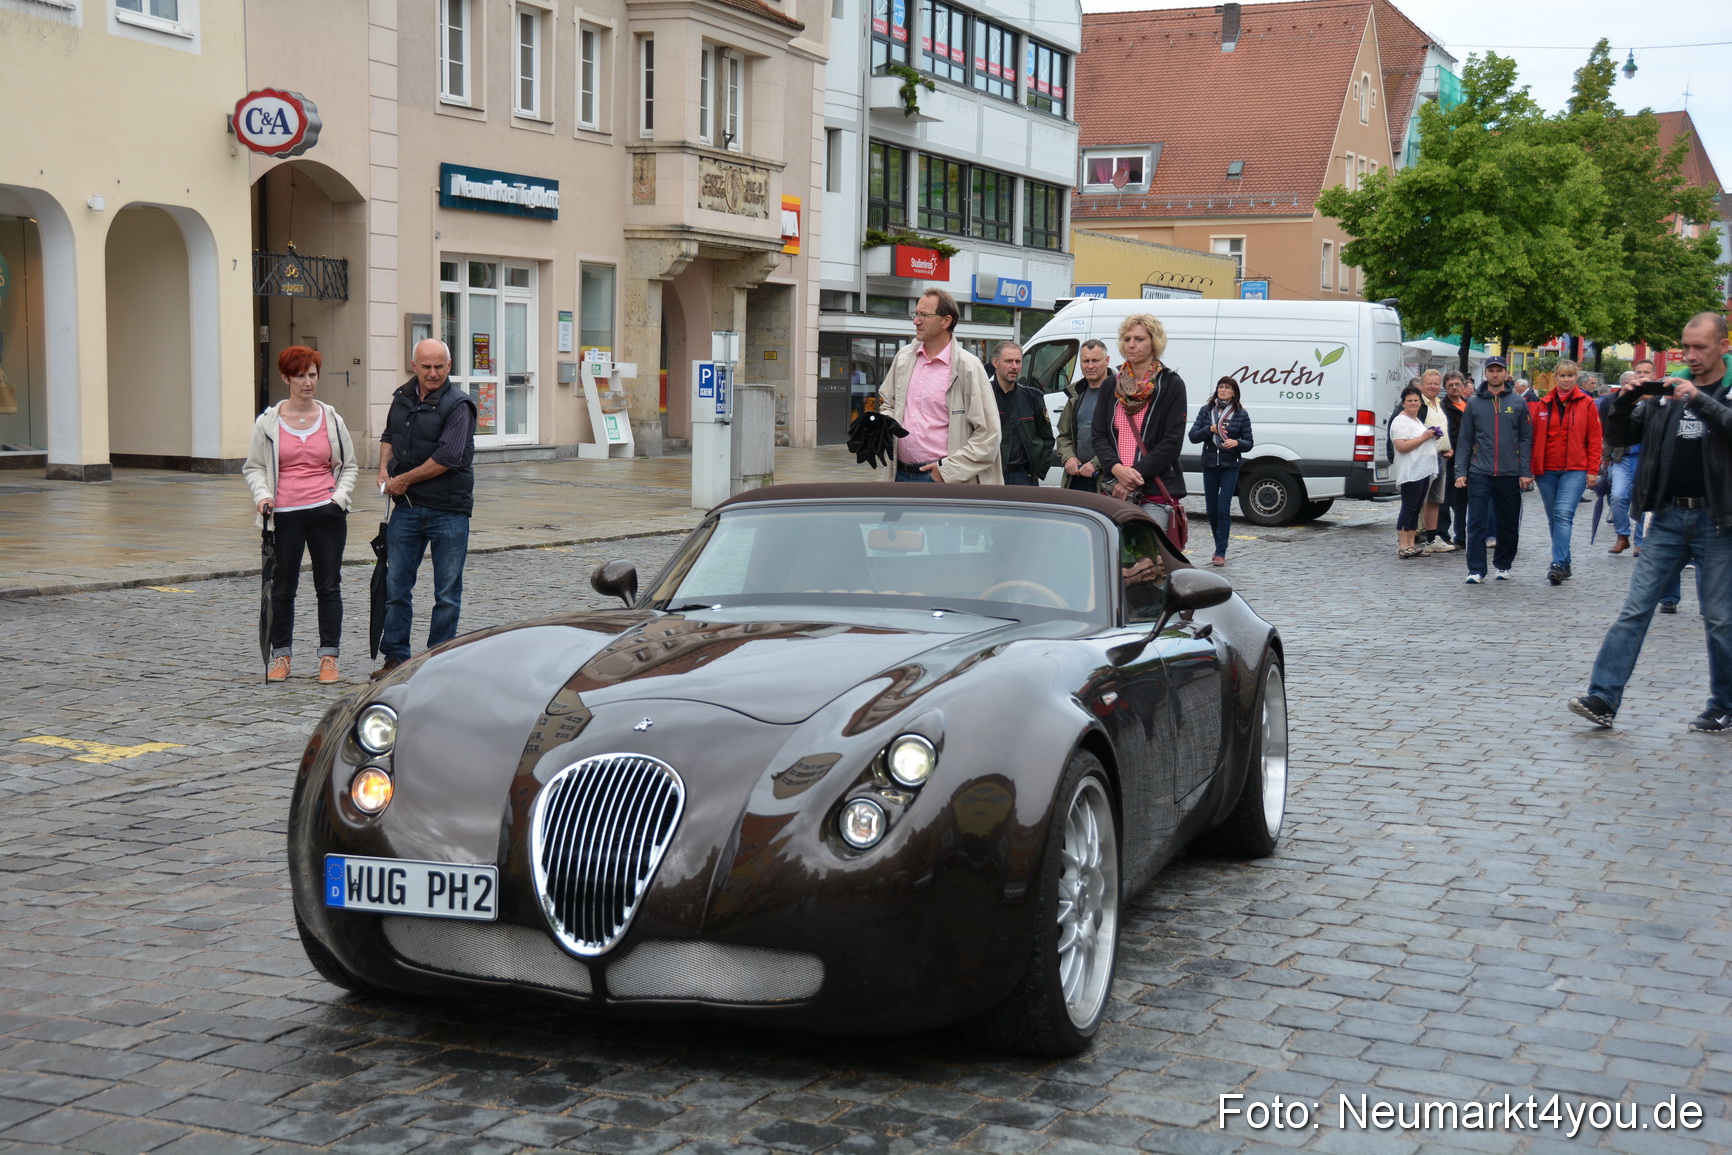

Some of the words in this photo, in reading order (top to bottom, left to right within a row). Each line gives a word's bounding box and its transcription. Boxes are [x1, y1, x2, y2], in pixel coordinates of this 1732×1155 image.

[245, 107, 293, 135] C&A
[450, 173, 517, 203] Neumarkter
[513, 182, 560, 209] Tagblatt
[232, 259, 238, 271] 7
[702, 368, 712, 384] P
[1279, 391, 1320, 400] FOODS
[331, 886, 341, 897] D
[346, 863, 407, 906] WUG
[427, 869, 493, 913] PH2
